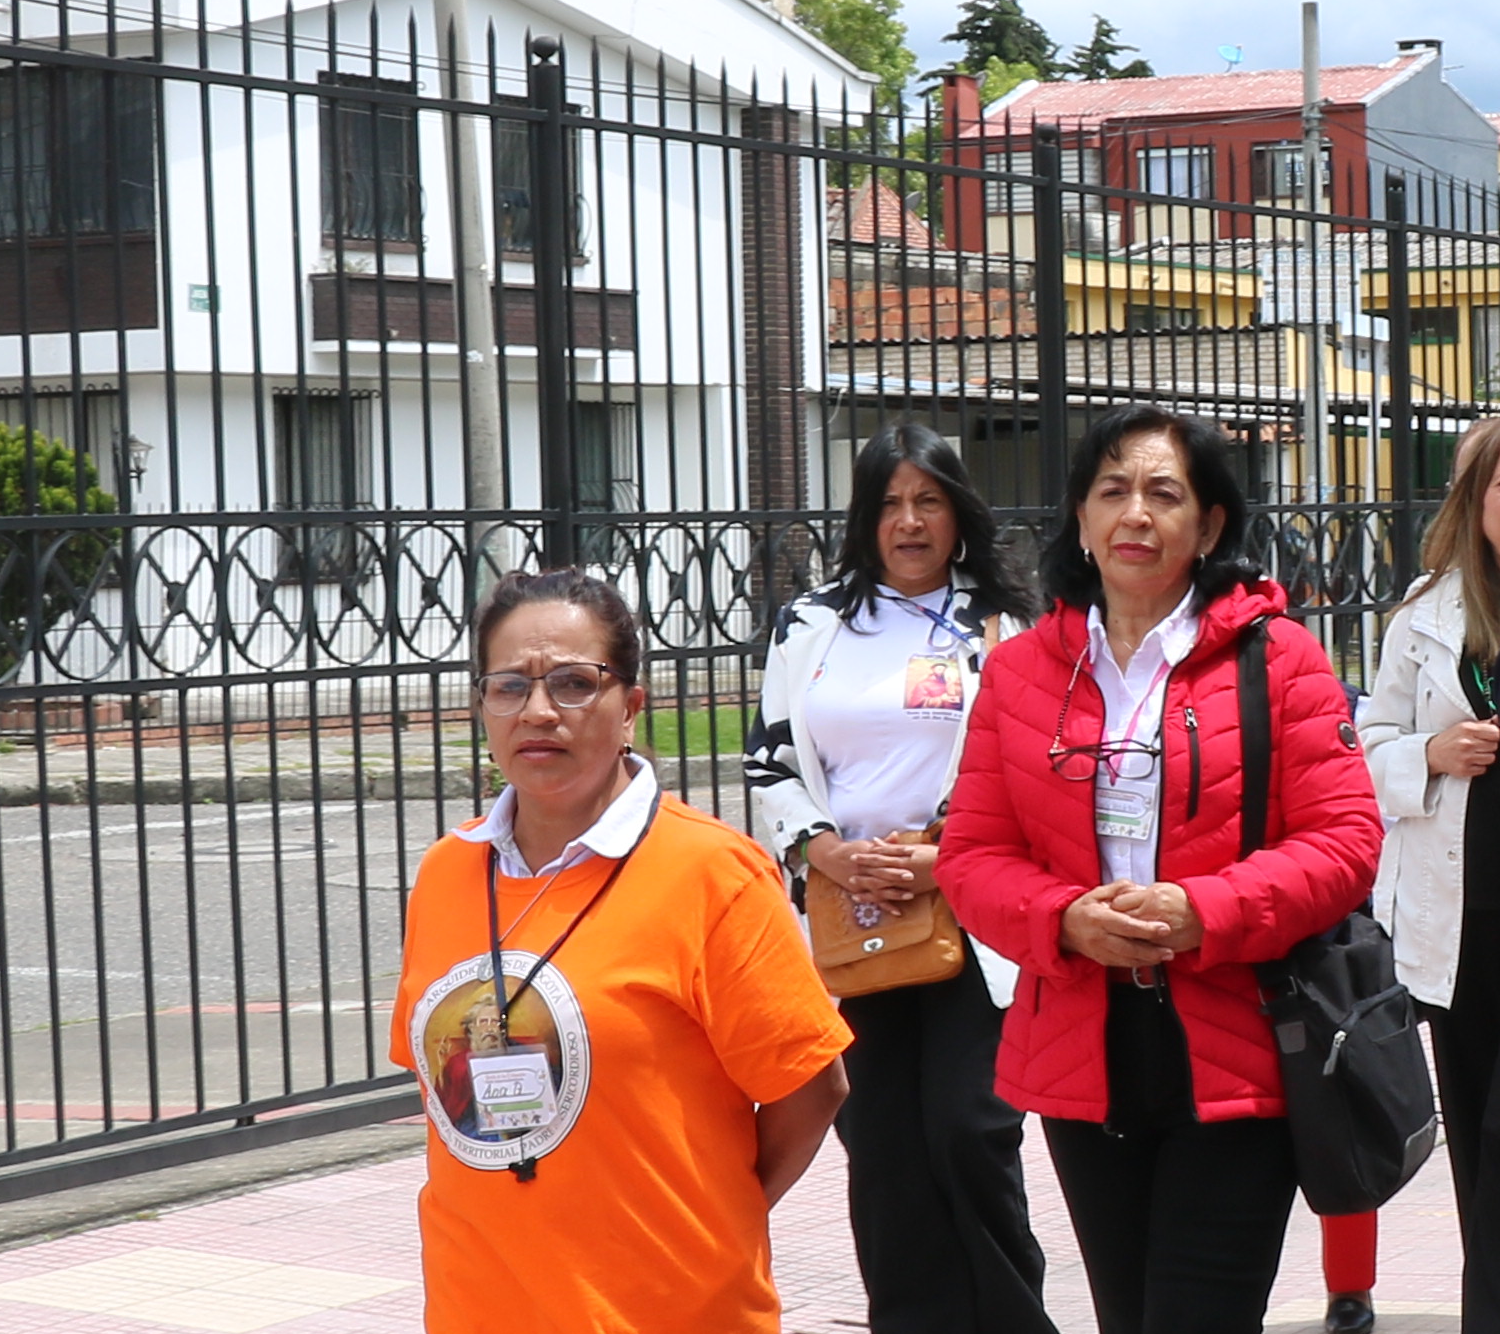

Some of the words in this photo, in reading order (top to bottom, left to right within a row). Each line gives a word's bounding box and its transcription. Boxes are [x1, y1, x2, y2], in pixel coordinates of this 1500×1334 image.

[512, 959, 531, 972] DE
[534, 969, 564, 1005] OGOTÁ
[453, 1137, 519, 1160] TERRITORIAL
[559, 1031, 580, 1122] SERICORDIOSO
[481, 1082, 508, 1100] Ana
